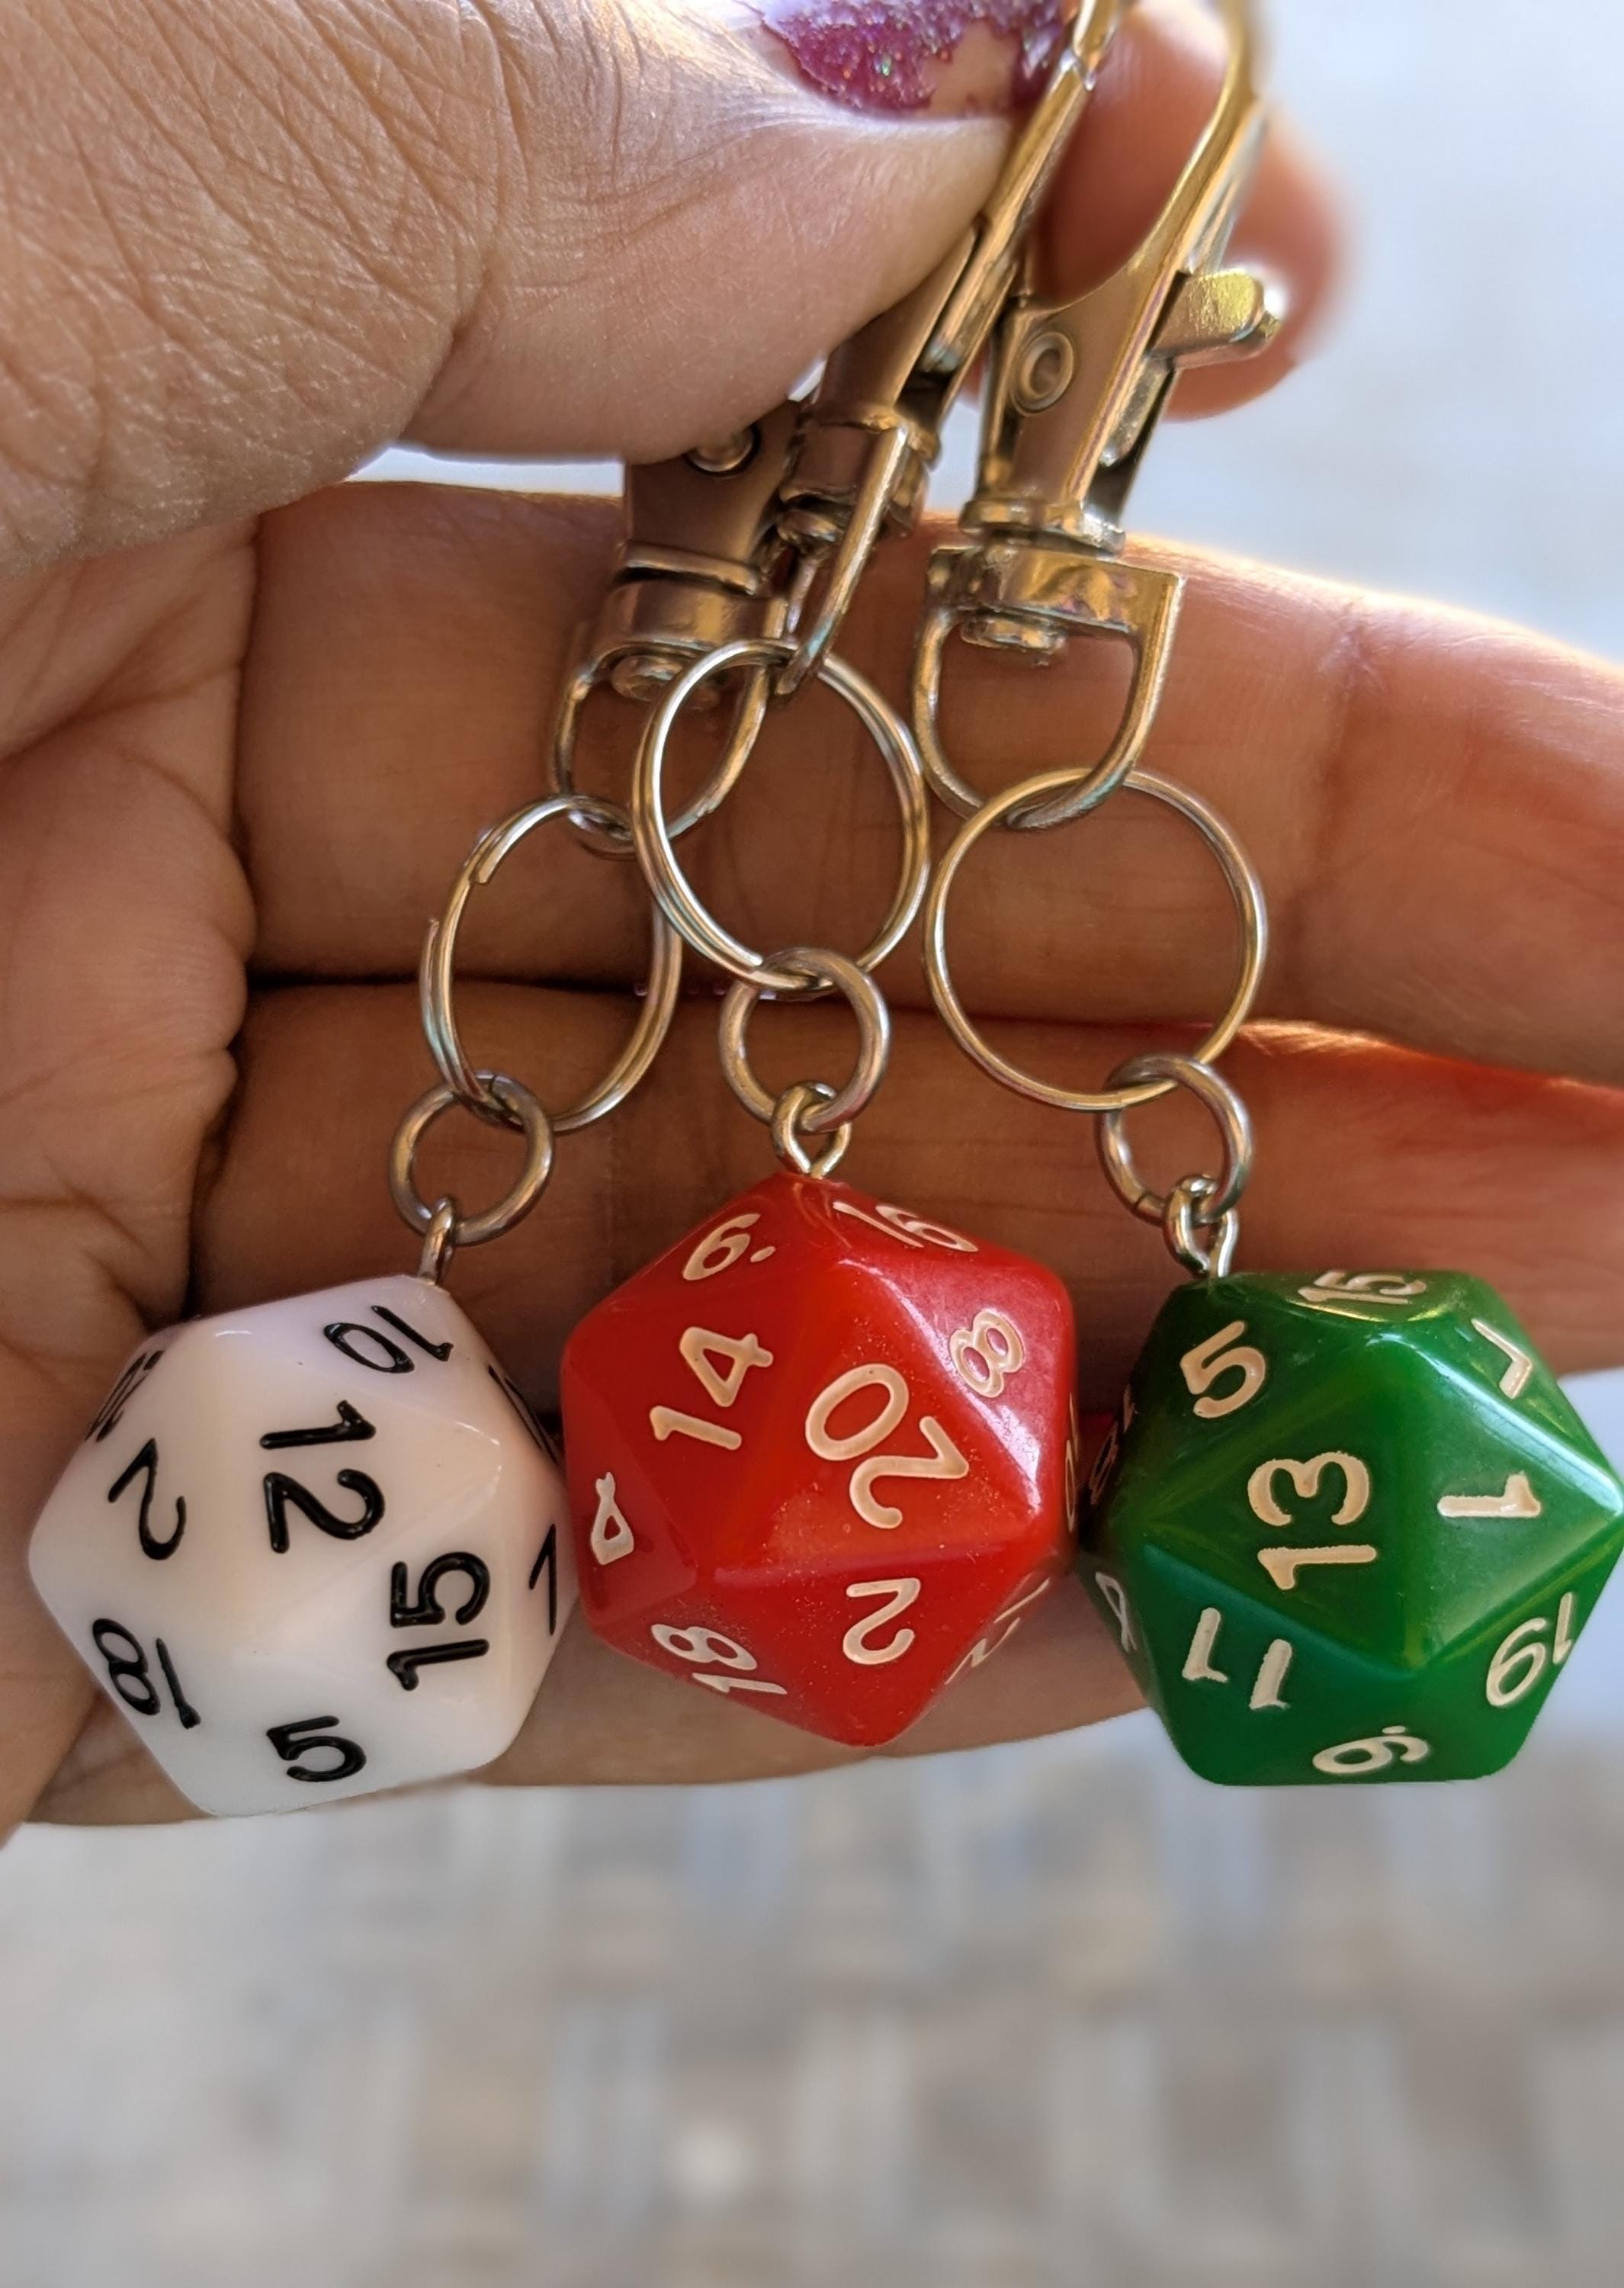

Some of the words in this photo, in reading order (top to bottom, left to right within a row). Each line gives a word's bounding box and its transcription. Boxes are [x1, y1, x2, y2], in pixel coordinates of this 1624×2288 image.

[832, 1201, 979, 1252] 16
[1298, 1271, 1427, 1305] 15
[323, 1305, 454, 1374] 10
[948, 1309, 1024, 1398] 8
[1179, 1320, 1266, 1419] 5
[650, 1326, 774, 1451] 14
[260, 1400, 385, 1554] 12
[805, 1364, 969, 1529] 20
[108, 1438, 186, 1561] 2
[591, 1472, 634, 1565] 4
[1247, 1451, 1377, 1591] 13
[1437, 1471, 1542, 1518] 1
[387, 1551, 490, 1692] 15
[651, 1623, 787, 1695] 18
[842, 1577, 920, 1666] 2
[92, 1618, 201, 1729] 18
[266, 1715, 367, 1782] 5
